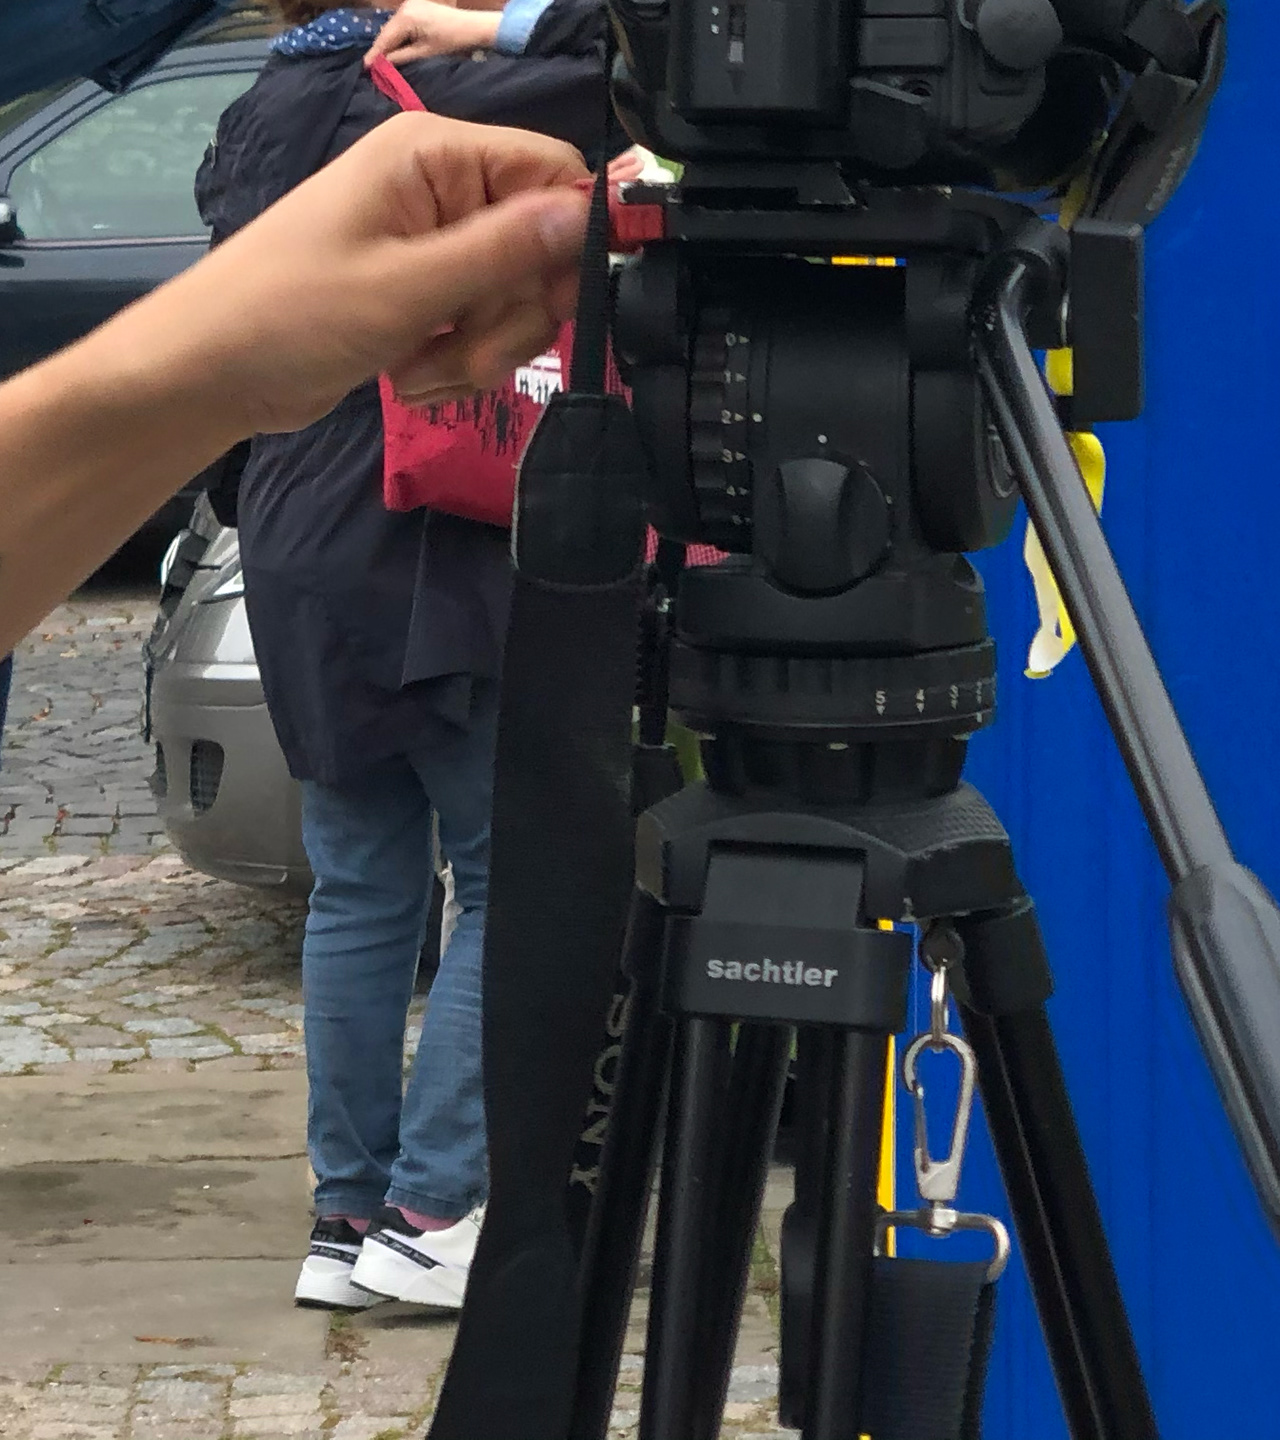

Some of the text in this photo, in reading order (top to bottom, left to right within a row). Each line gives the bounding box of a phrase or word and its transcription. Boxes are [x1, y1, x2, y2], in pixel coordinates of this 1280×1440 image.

[721, 409, 732, 425] 2
[875, 689, 886, 705] 5
[707, 958, 839, 988] sachtler
[570, 994, 634, 1196] SONY
